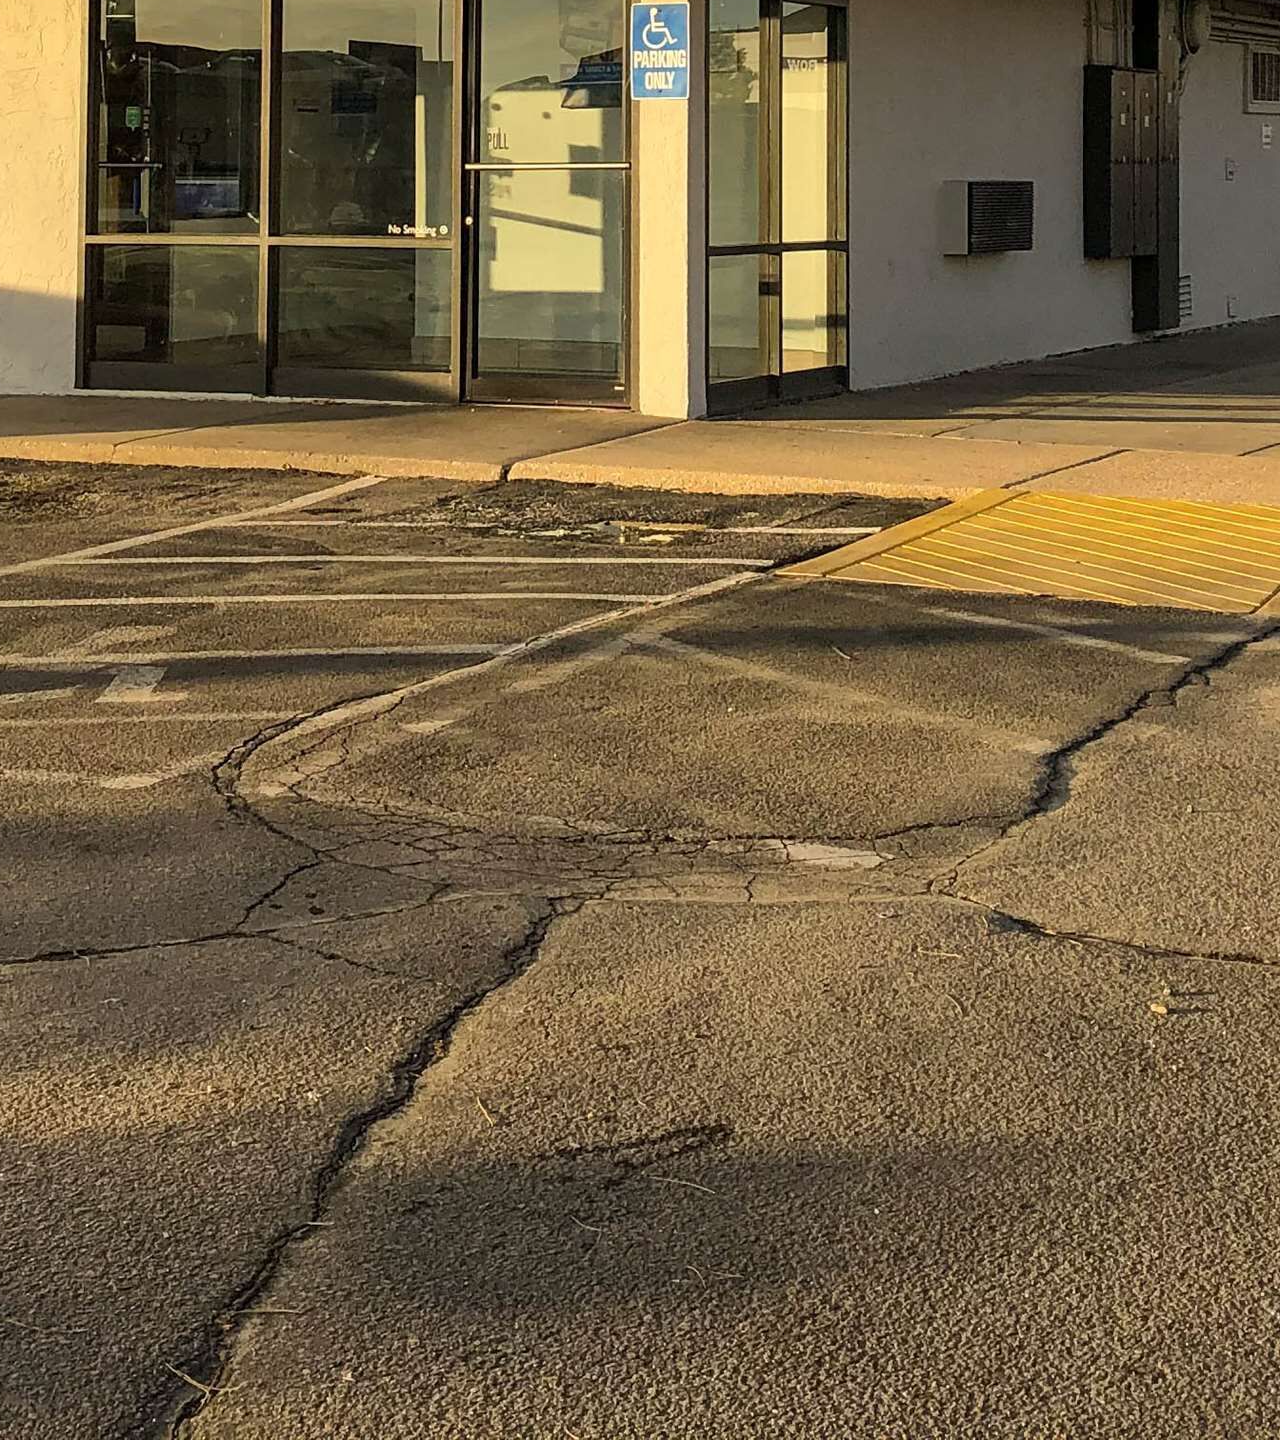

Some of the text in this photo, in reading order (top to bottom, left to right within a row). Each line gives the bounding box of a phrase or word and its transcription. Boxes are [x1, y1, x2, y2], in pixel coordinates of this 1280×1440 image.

[634, 50, 686, 68] PARKING
[645, 72, 674, 90] ONLY
[487, 132, 509, 150] PULL
[388, 224, 437, 237] No Smoking
